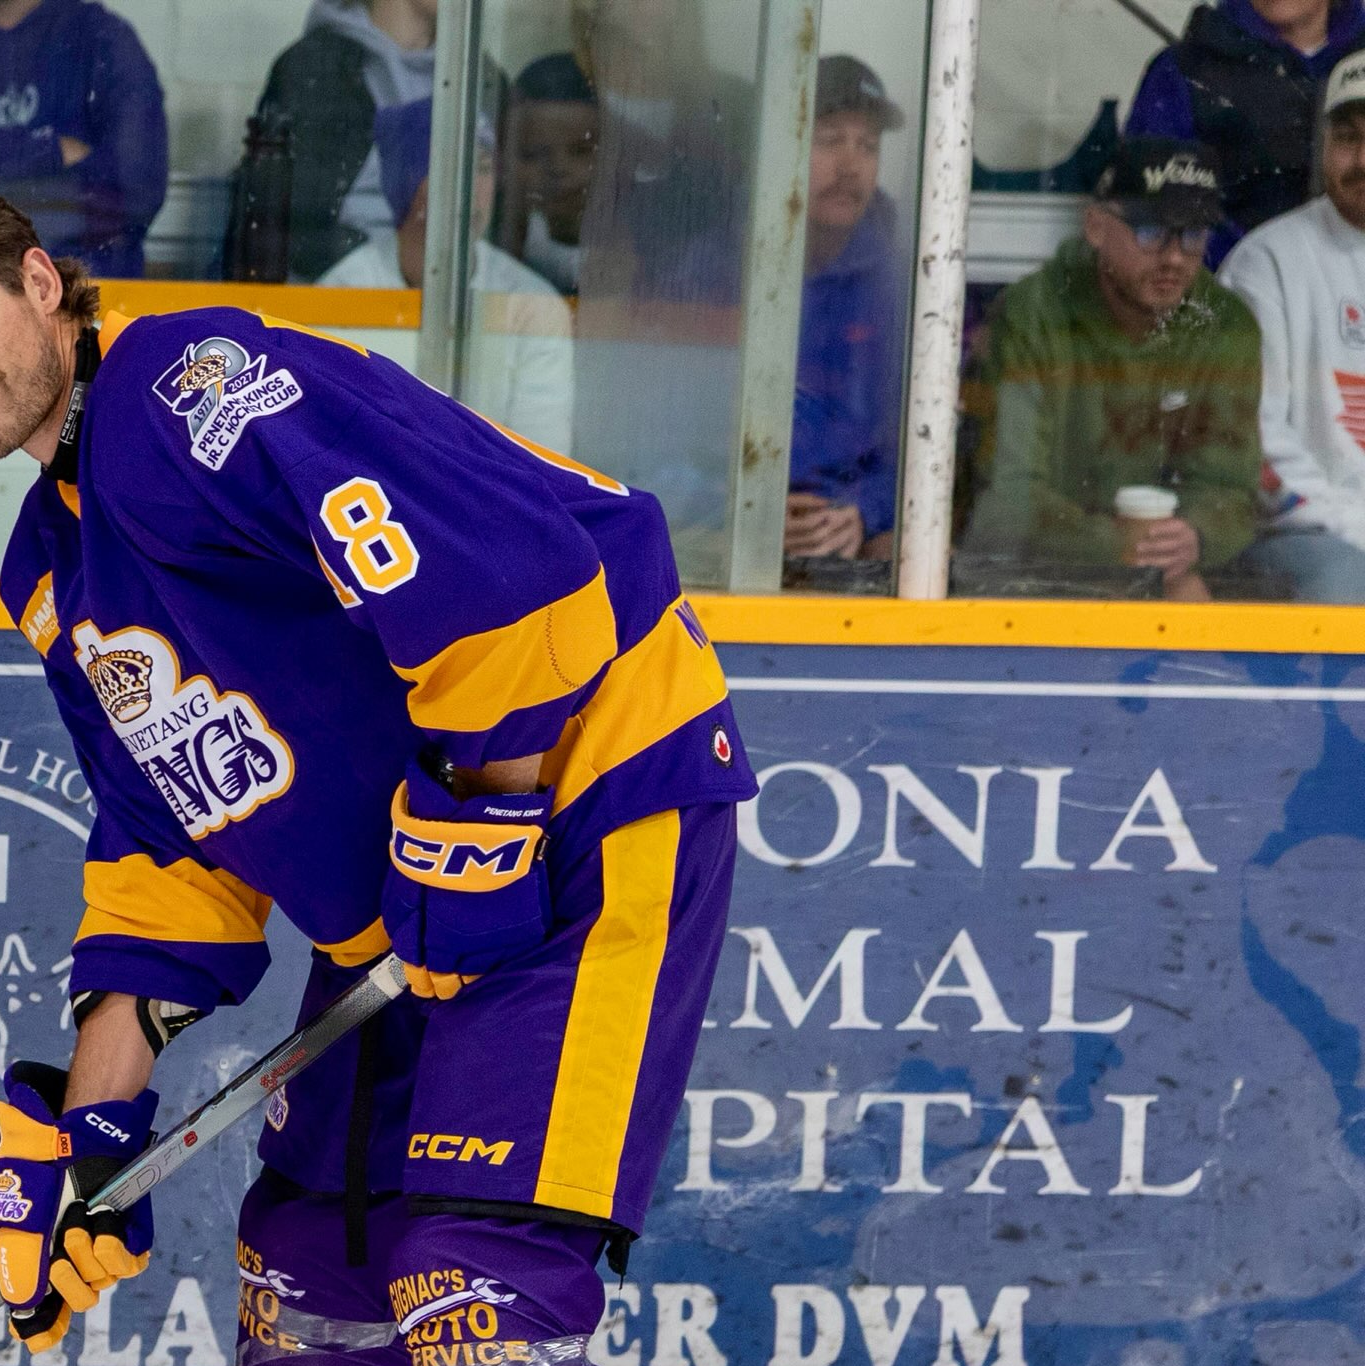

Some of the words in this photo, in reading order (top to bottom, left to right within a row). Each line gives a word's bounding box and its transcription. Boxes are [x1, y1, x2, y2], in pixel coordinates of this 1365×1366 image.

[228, 372, 253, 393] 2027
[243, 376, 284, 405] KINGS
[193, 397, 214, 423] 1977
[207, 449, 223, 466] JR.
[218, 434, 230, 446] C
[264, 384, 298, 410] CLUB
[391, 826, 530, 877] CM
[700, 928, 1134, 1033] MAL
[85, 1112, 131, 1143] CCM
[408, 1133, 515, 1165] CCM
[0, 1247, 15, 1294] CCM
[389, 1269, 465, 1316] GIGNAC'S
